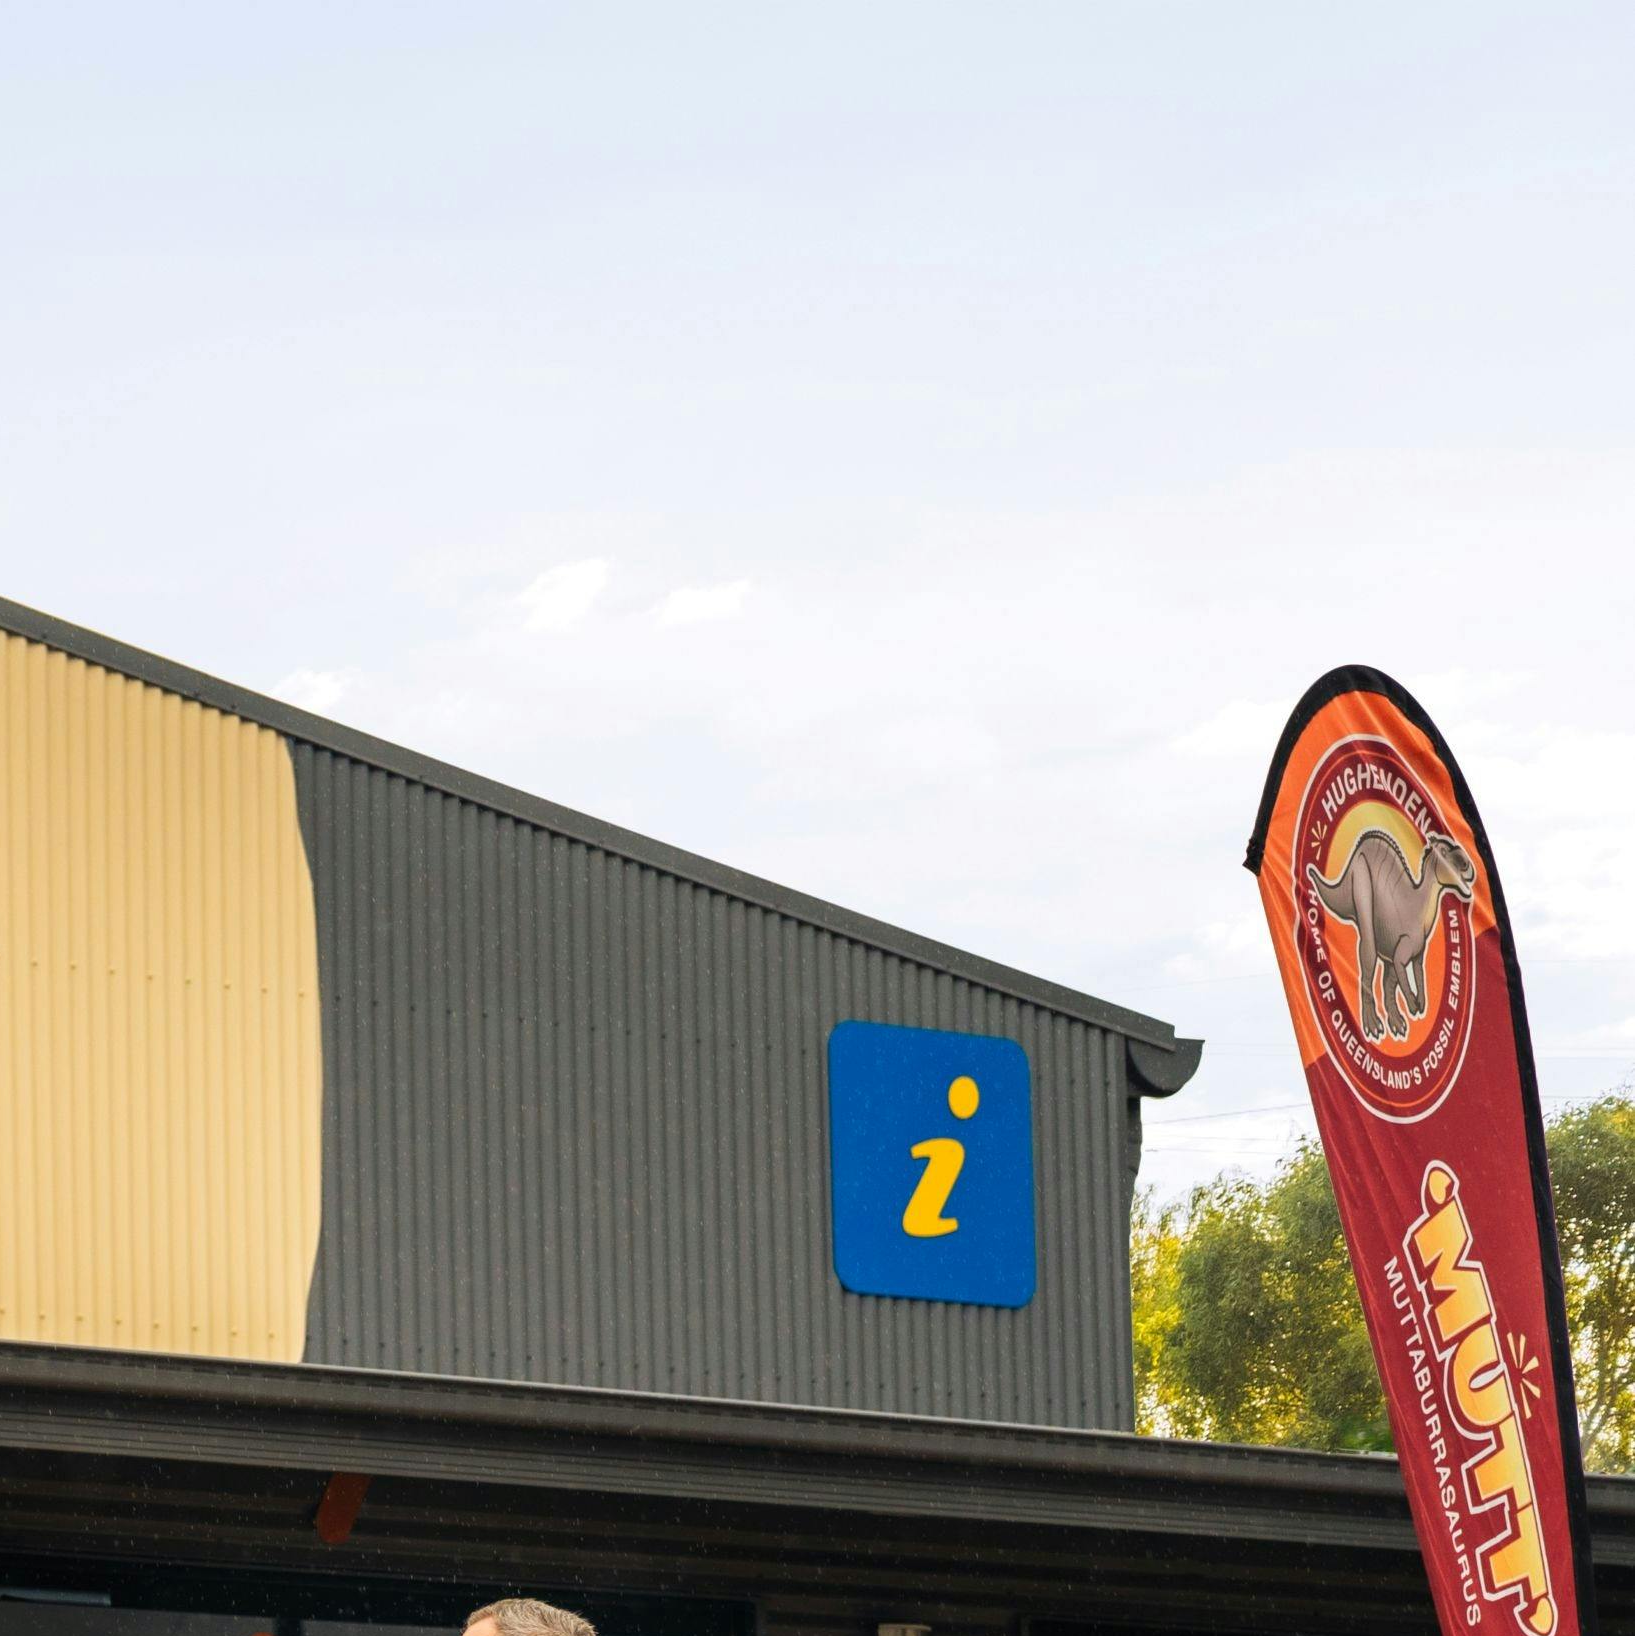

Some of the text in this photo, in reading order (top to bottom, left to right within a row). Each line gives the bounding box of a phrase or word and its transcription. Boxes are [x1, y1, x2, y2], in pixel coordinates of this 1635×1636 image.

[1321, 763, 1431, 836] HUGHENDEN
[1307, 889, 1461, 1090] HOME OF QUEENSLAND'S FOSSIL EMBLEM
[1383, 1256, 1483, 1627] MUTTABURRASAURUS
[1414, 1198, 1552, 1600] MUTT
